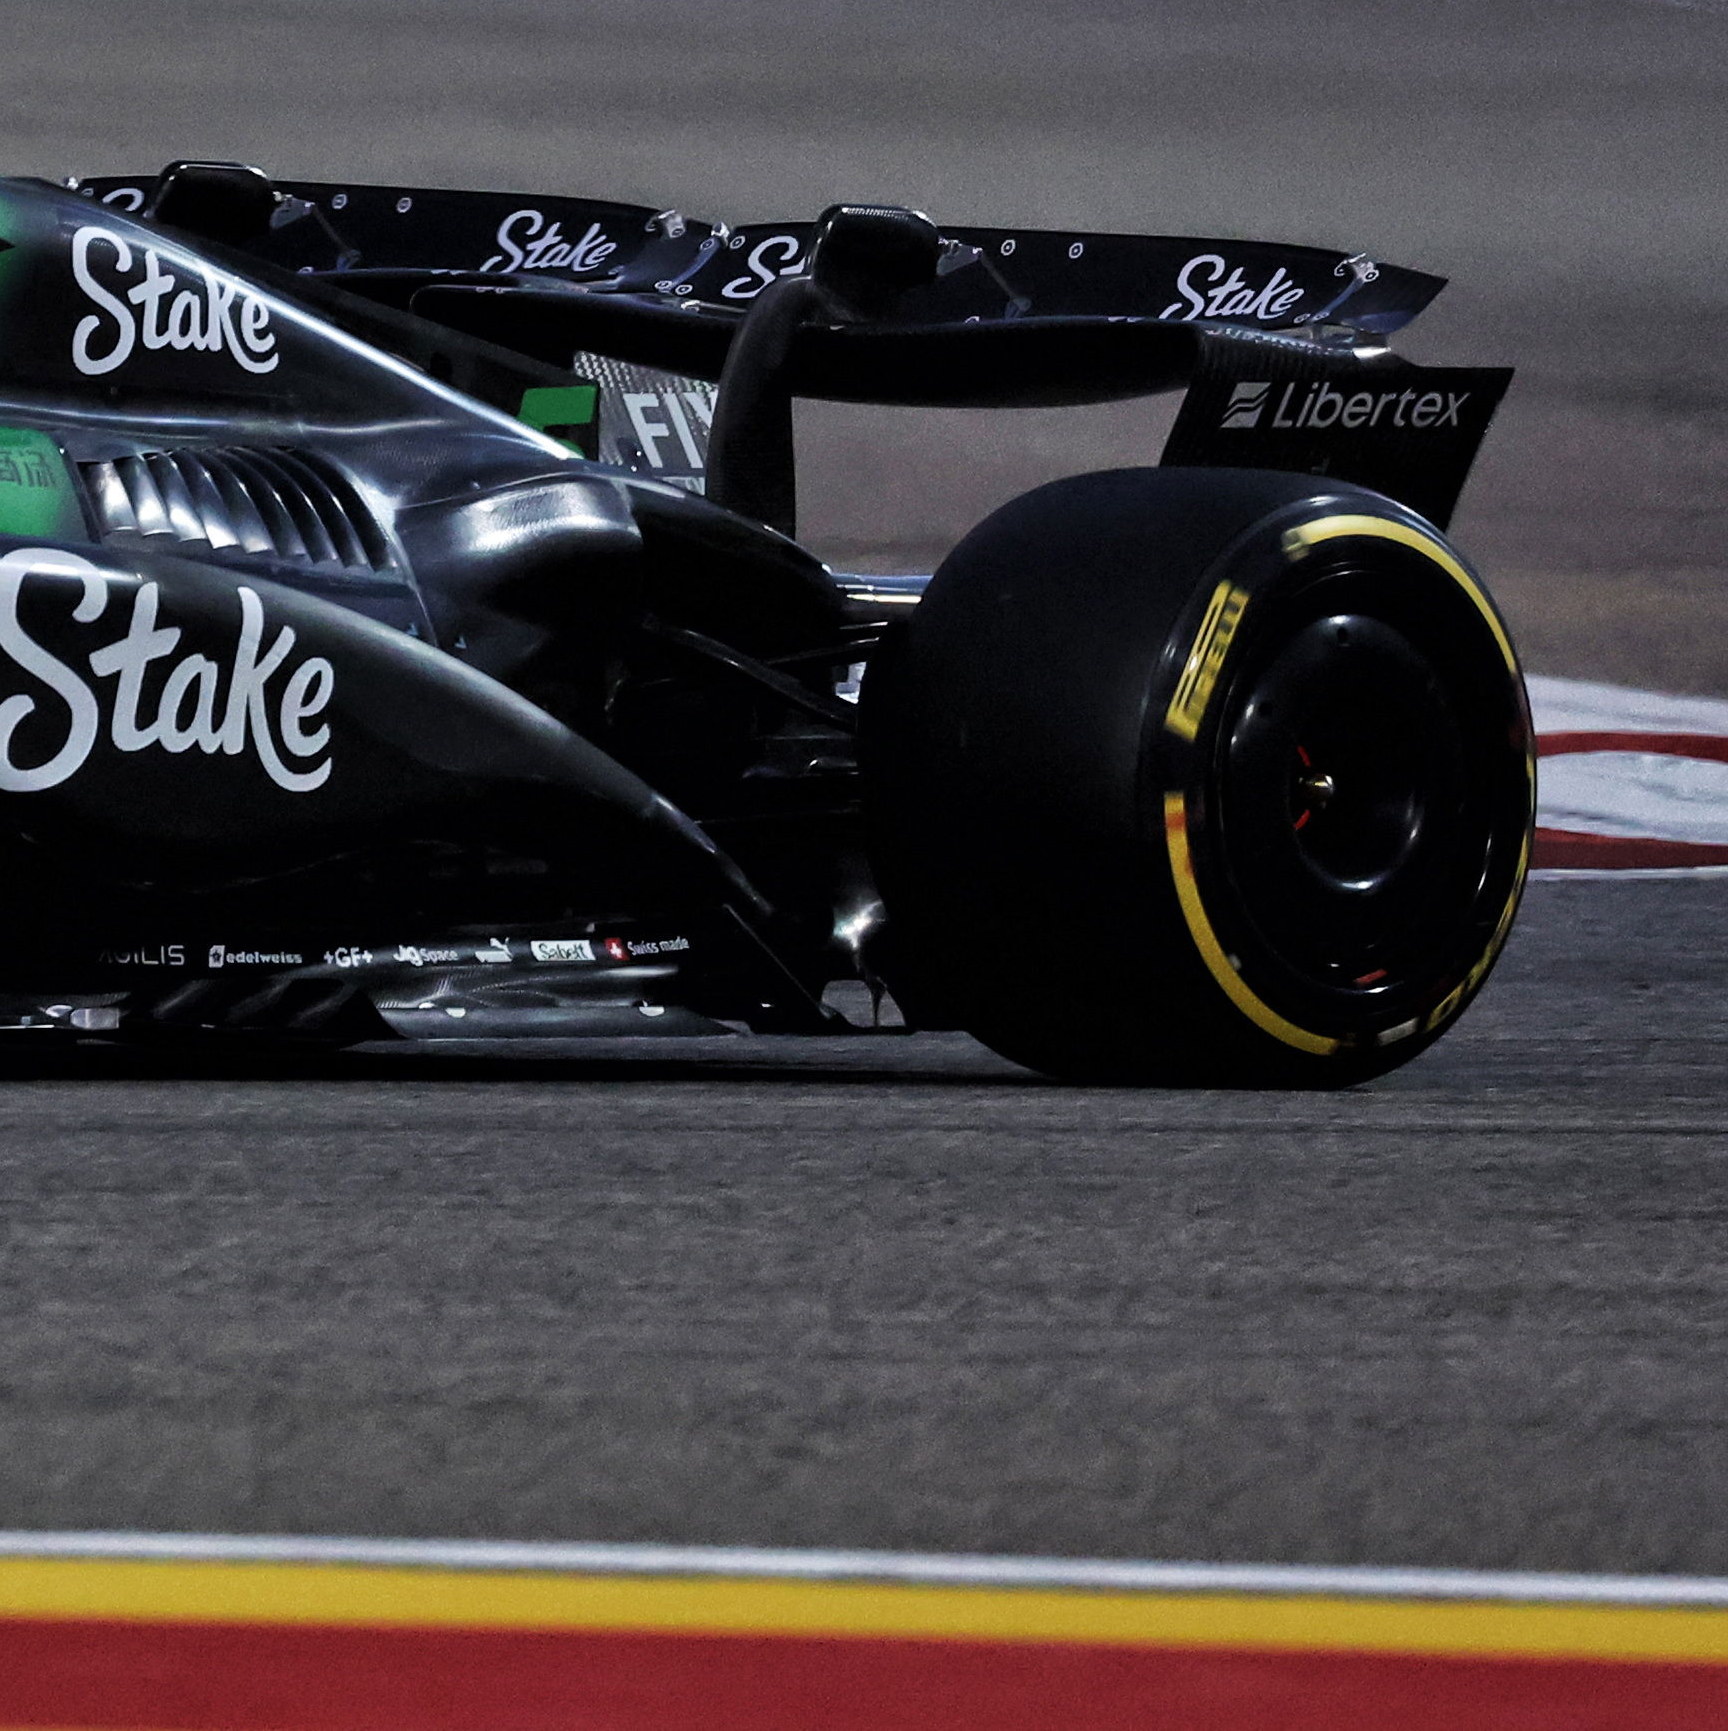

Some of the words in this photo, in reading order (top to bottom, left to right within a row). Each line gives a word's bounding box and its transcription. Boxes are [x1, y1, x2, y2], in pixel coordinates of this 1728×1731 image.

[479, 209, 618, 274] Stake
[72, 226, 279, 374] Stake
[1158, 253, 1306, 321] Stake
[1271, 381, 1472, 429] Libertex
[224, 950, 303, 965] edelweiss
[626, 940, 659, 957] Swiss
